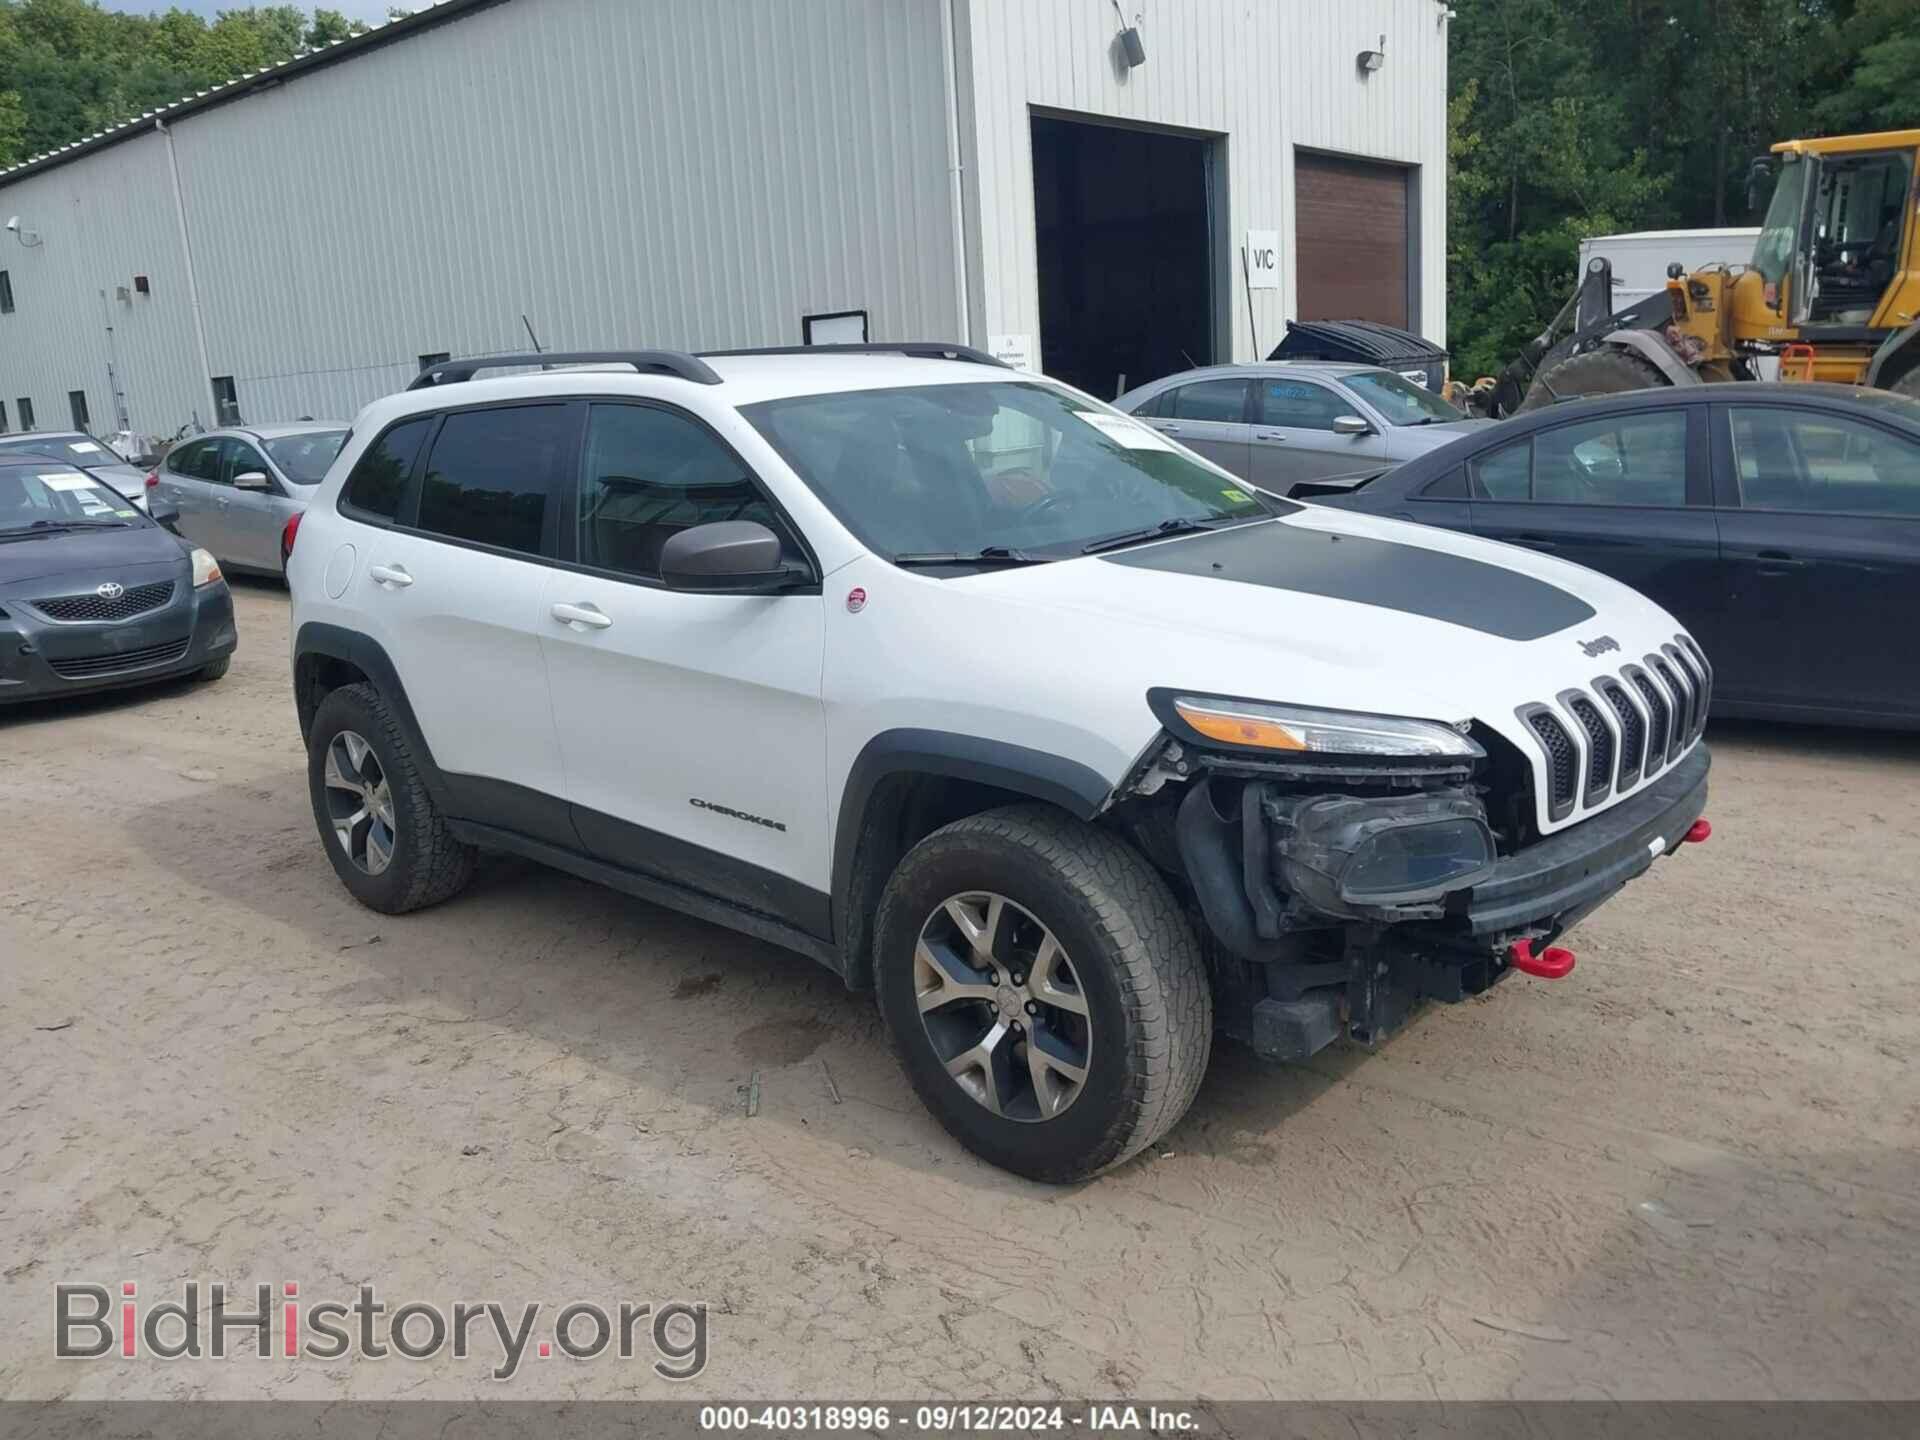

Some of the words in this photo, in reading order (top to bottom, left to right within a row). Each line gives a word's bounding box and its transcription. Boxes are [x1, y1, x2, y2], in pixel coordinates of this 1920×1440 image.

[1253, 248, 1274, 270] VIC
[1576, 635, 1621, 658] Jeep
[689, 798, 787, 833] CHEROKEE
